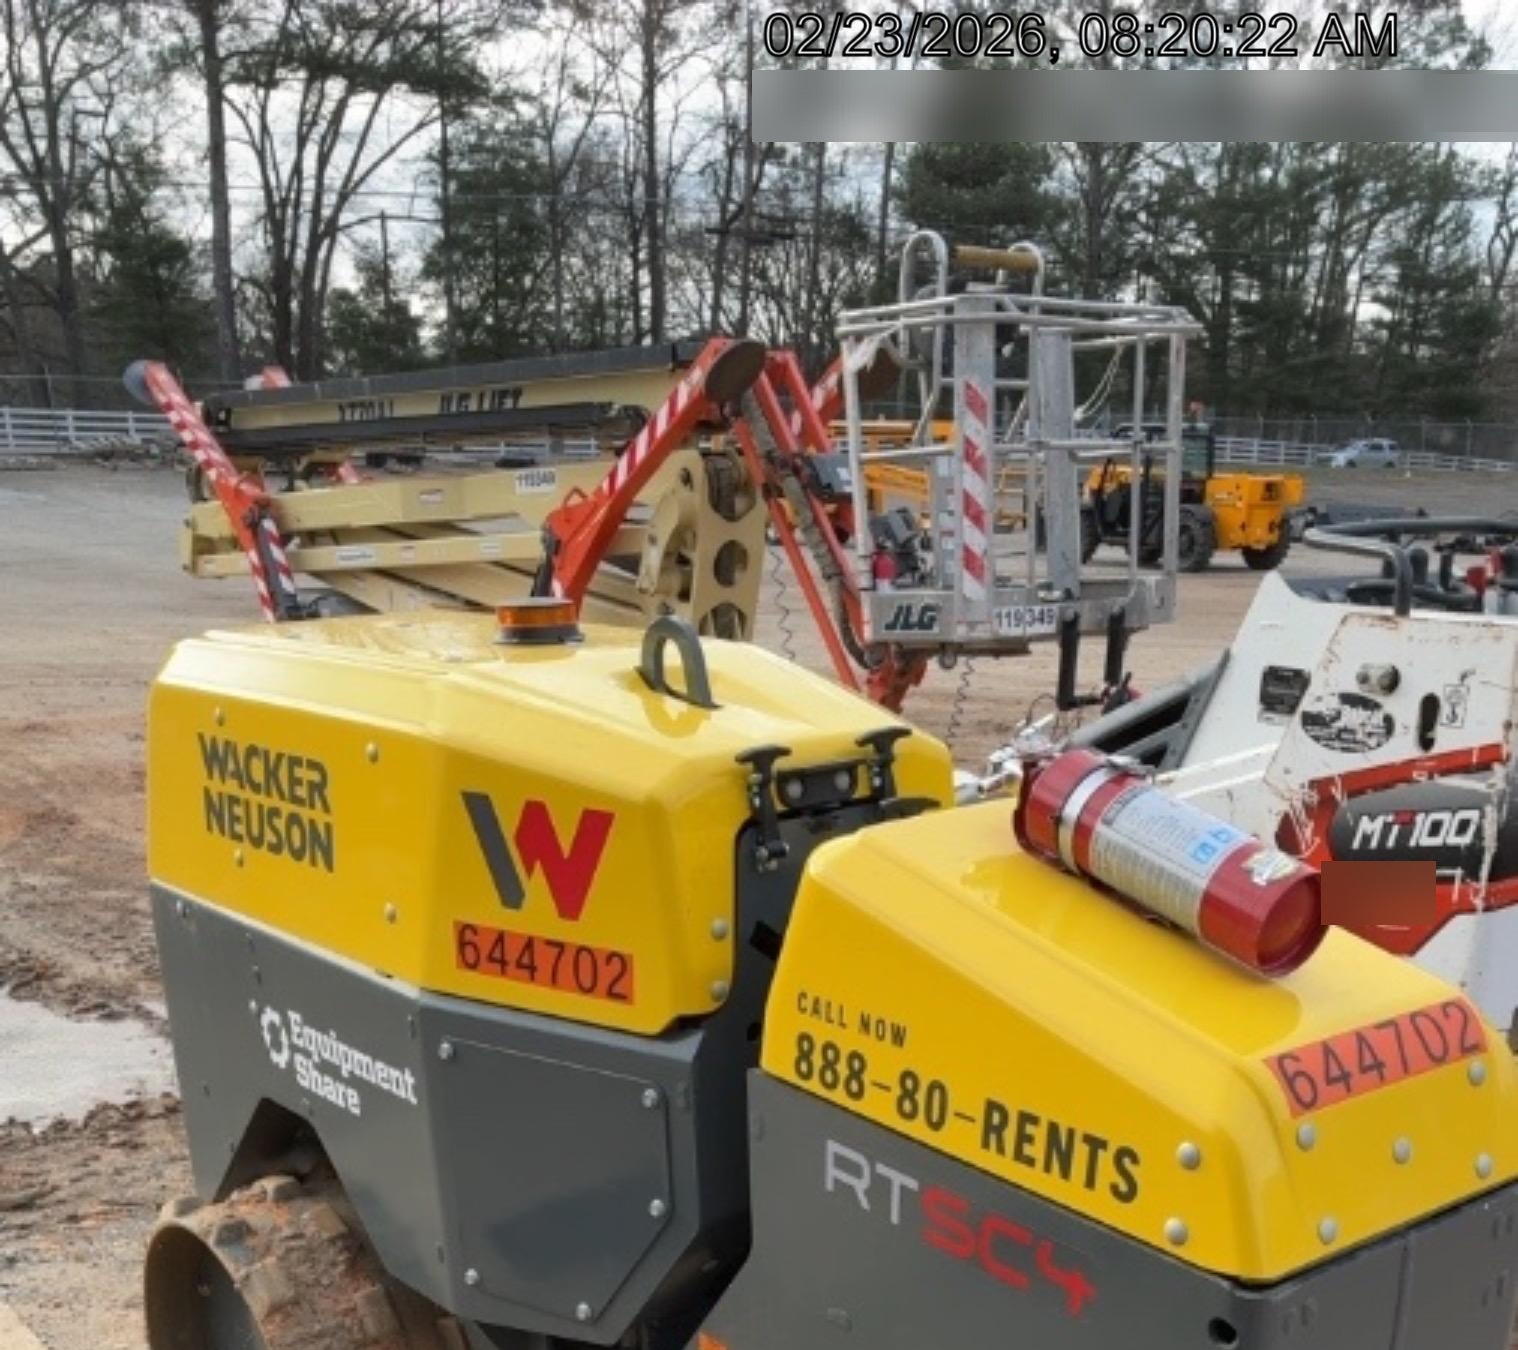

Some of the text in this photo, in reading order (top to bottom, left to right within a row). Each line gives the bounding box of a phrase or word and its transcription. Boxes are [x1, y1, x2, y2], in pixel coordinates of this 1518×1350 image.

[884, 604, 939, 631] JLG
[994, 607, 1055, 629] 119349
[197, 732, 331, 814] WACKER
[203, 785, 334, 873] NEUSON
[1352, 808, 1480, 850] MT100
[456, 922, 630, 1001] 644702
[286, 1008, 417, 1106] Equipment
[796, 990, 908, 1049] CALL NOW
[1277, 1001, 1481, 1110] 644702
[293, 1052, 361, 1117] Share
[794, 1030, 1142, 1205] 888-80-RENTS
